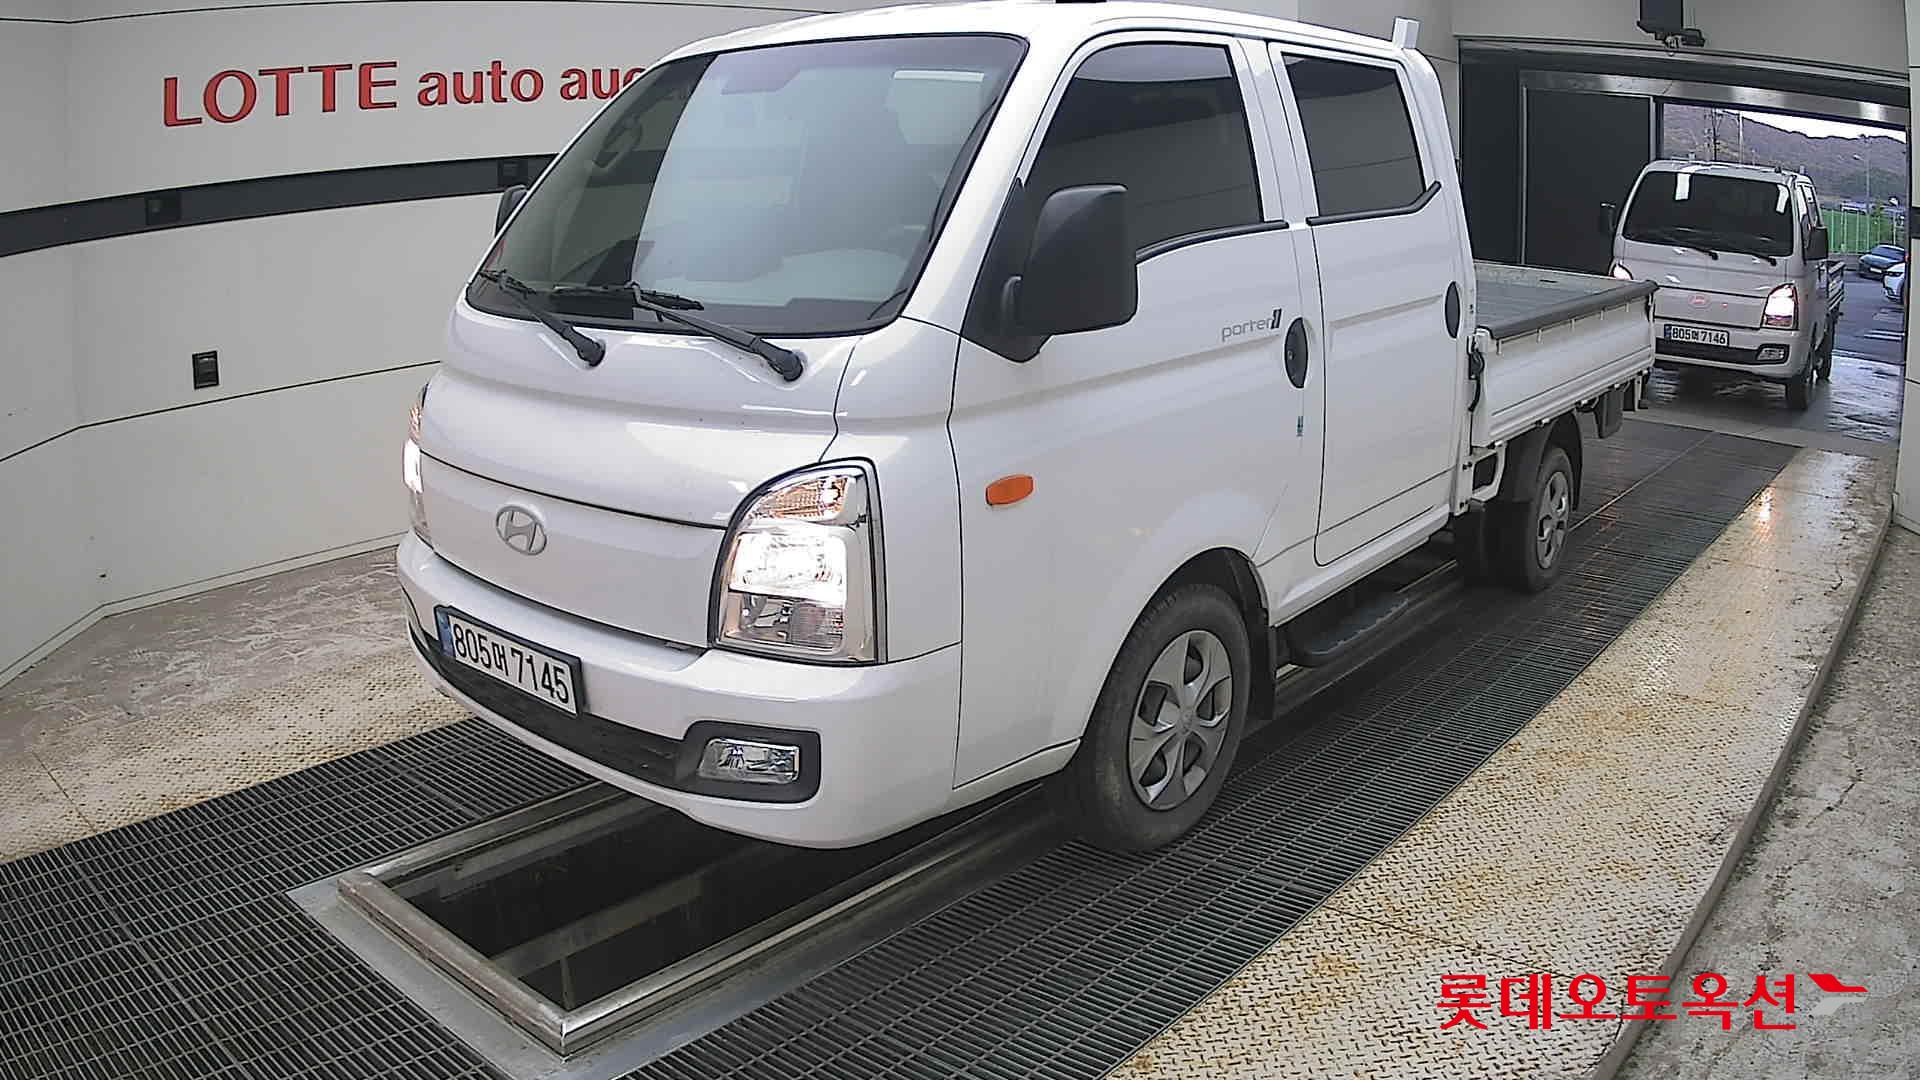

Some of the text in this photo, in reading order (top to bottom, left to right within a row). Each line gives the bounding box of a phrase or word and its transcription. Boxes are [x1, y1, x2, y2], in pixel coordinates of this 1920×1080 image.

[164, 61, 397, 127] LOTTE
[417, 60, 544, 107] auto
[453, 623, 569, 704] 805머 7145
